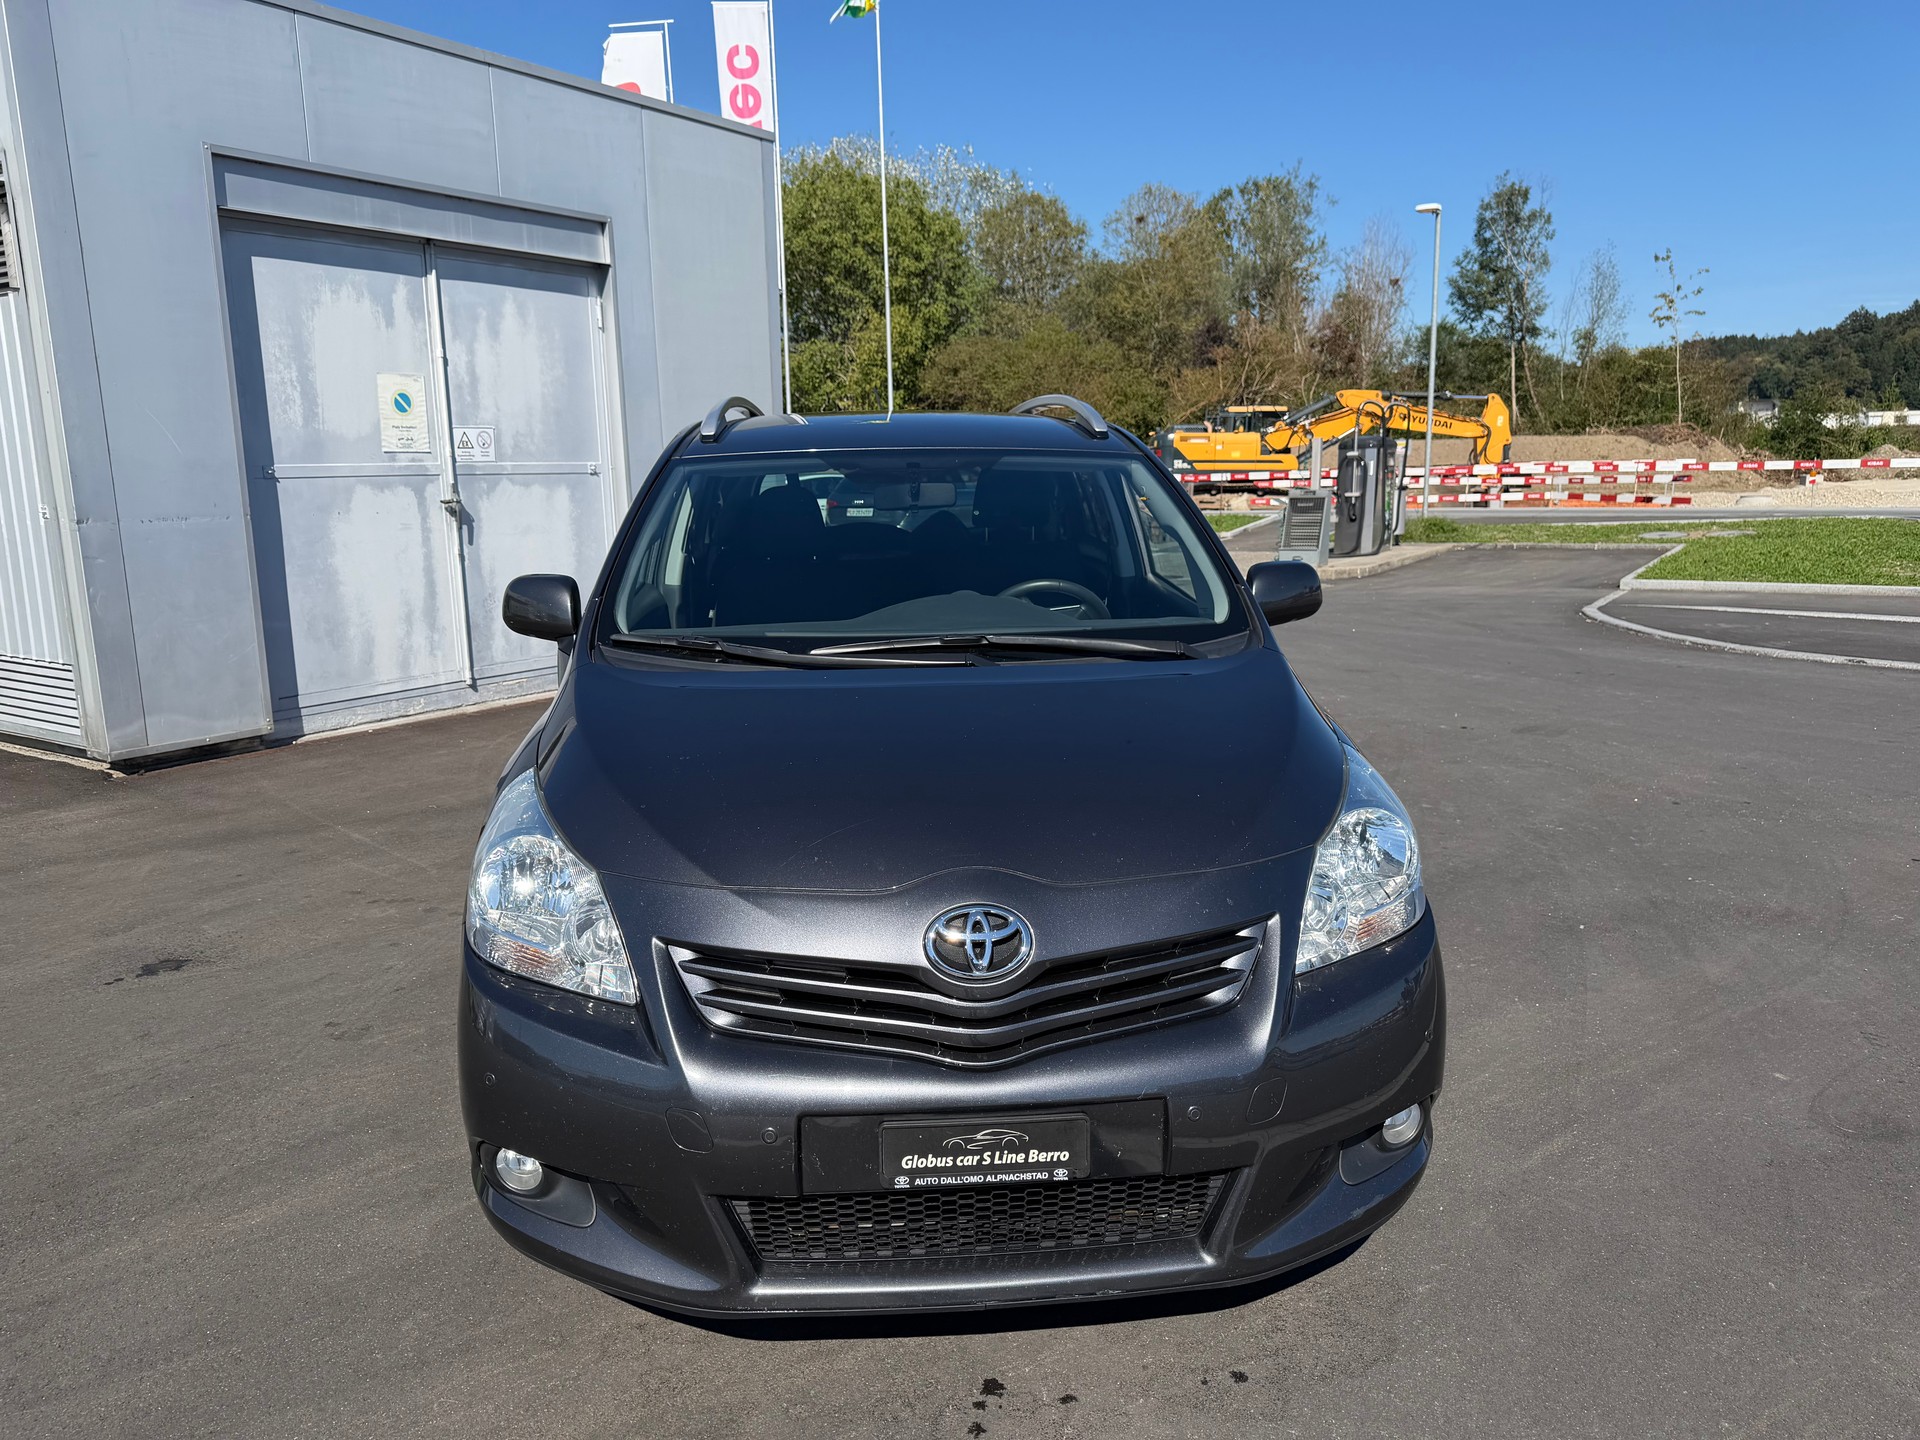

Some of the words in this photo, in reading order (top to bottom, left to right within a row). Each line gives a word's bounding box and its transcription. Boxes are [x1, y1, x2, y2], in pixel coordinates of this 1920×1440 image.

[726, 44, 763, 128] GC
[1403, 413, 1453, 430] HYUDAI
[901, 1153, 954, 1169] Globus
[956, 1155, 980, 1166] car
[982, 1151, 992, 1165] S
[994, 1150, 1026, 1164] Line
[1028, 1149, 1070, 1163] Berro
[914, 1177, 939, 1186] AUTO
[940, 1175, 984, 1184] DALL'OMO
[986, 1172, 1049, 1182] ALPNACHSTAD
